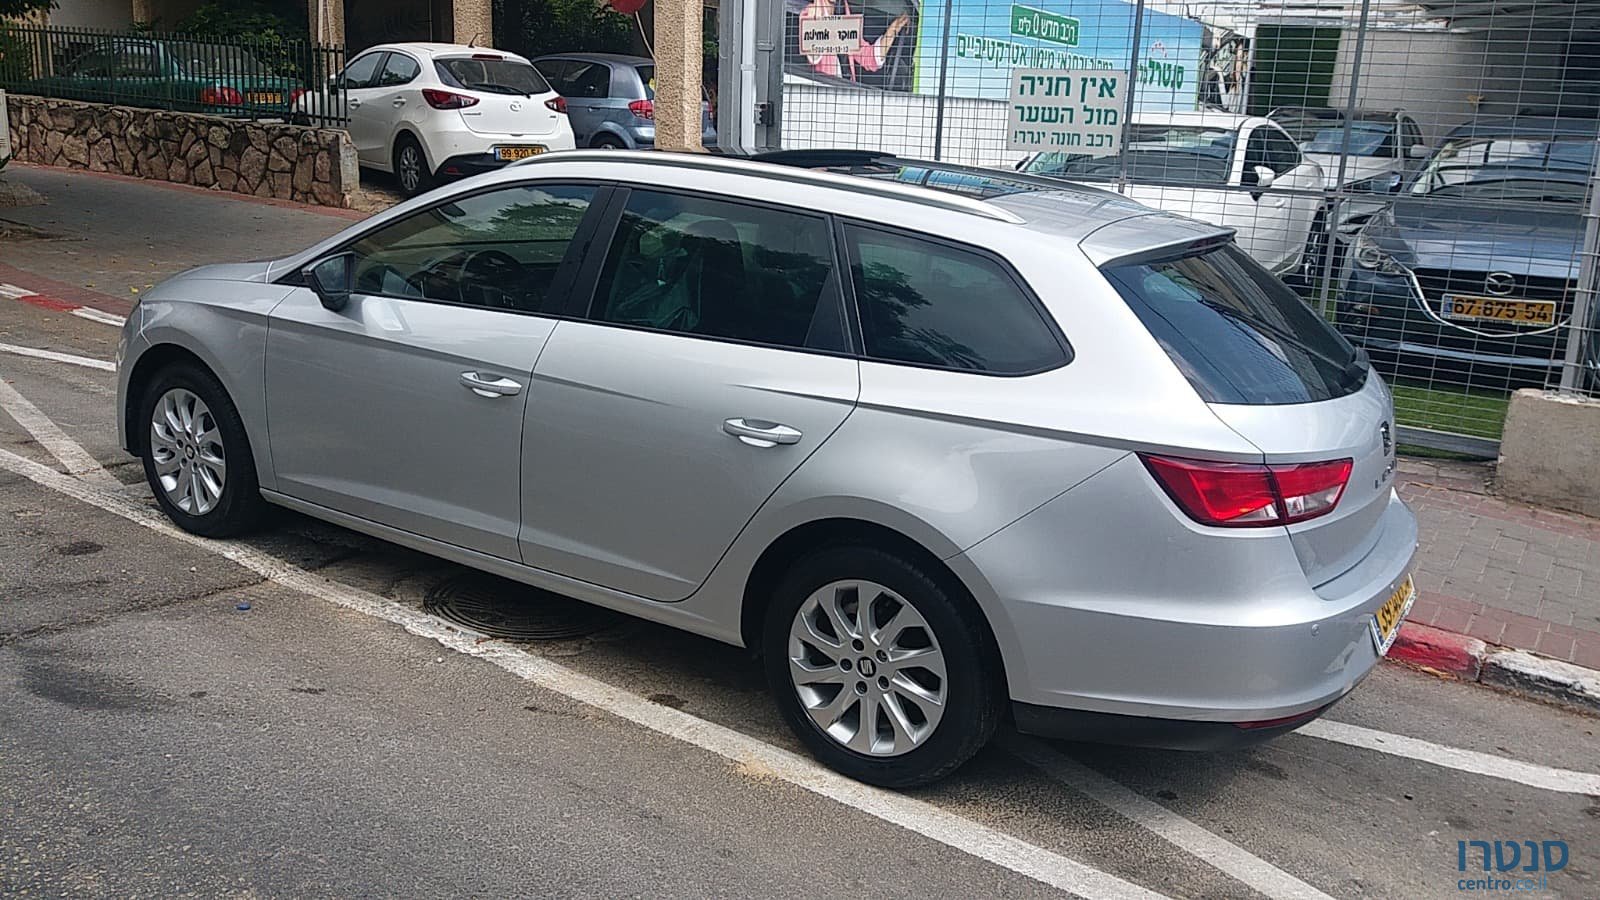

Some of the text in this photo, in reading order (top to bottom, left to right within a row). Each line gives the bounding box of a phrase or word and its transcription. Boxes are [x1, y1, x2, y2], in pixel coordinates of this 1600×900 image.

[1033, 13, 1040, 35] 0
[1041, 17, 1060, 39] חדש
[1020, 75, 1117, 103] אין חניה
[1014, 104, 1118, 126] מול השער
[1013, 130, 1114, 148] רכב חונה יגרר!
